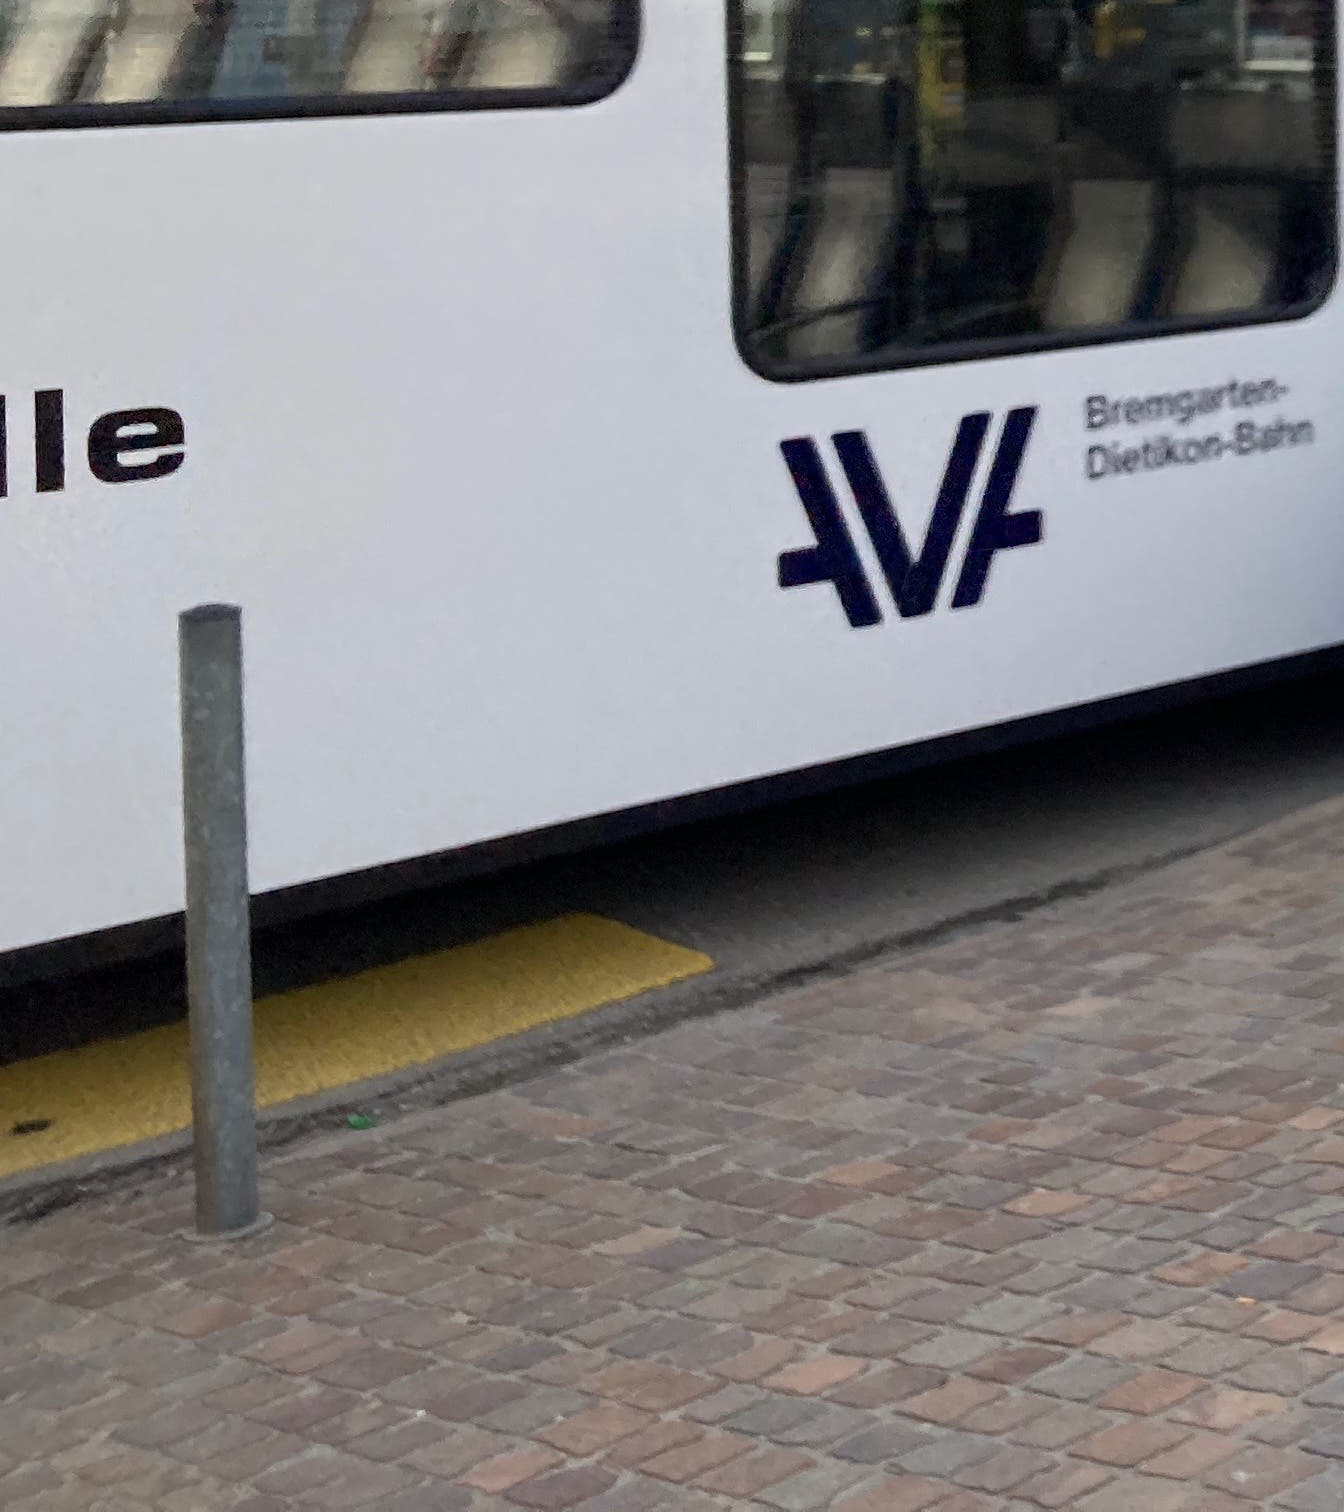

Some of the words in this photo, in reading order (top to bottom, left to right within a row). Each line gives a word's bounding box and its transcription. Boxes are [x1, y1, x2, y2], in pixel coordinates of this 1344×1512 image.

[1085, 378, 1288, 431] Bremgarten-
[0, 388, 186, 497] le
[1085, 418, 1316, 481] Dietikon-Bahn
